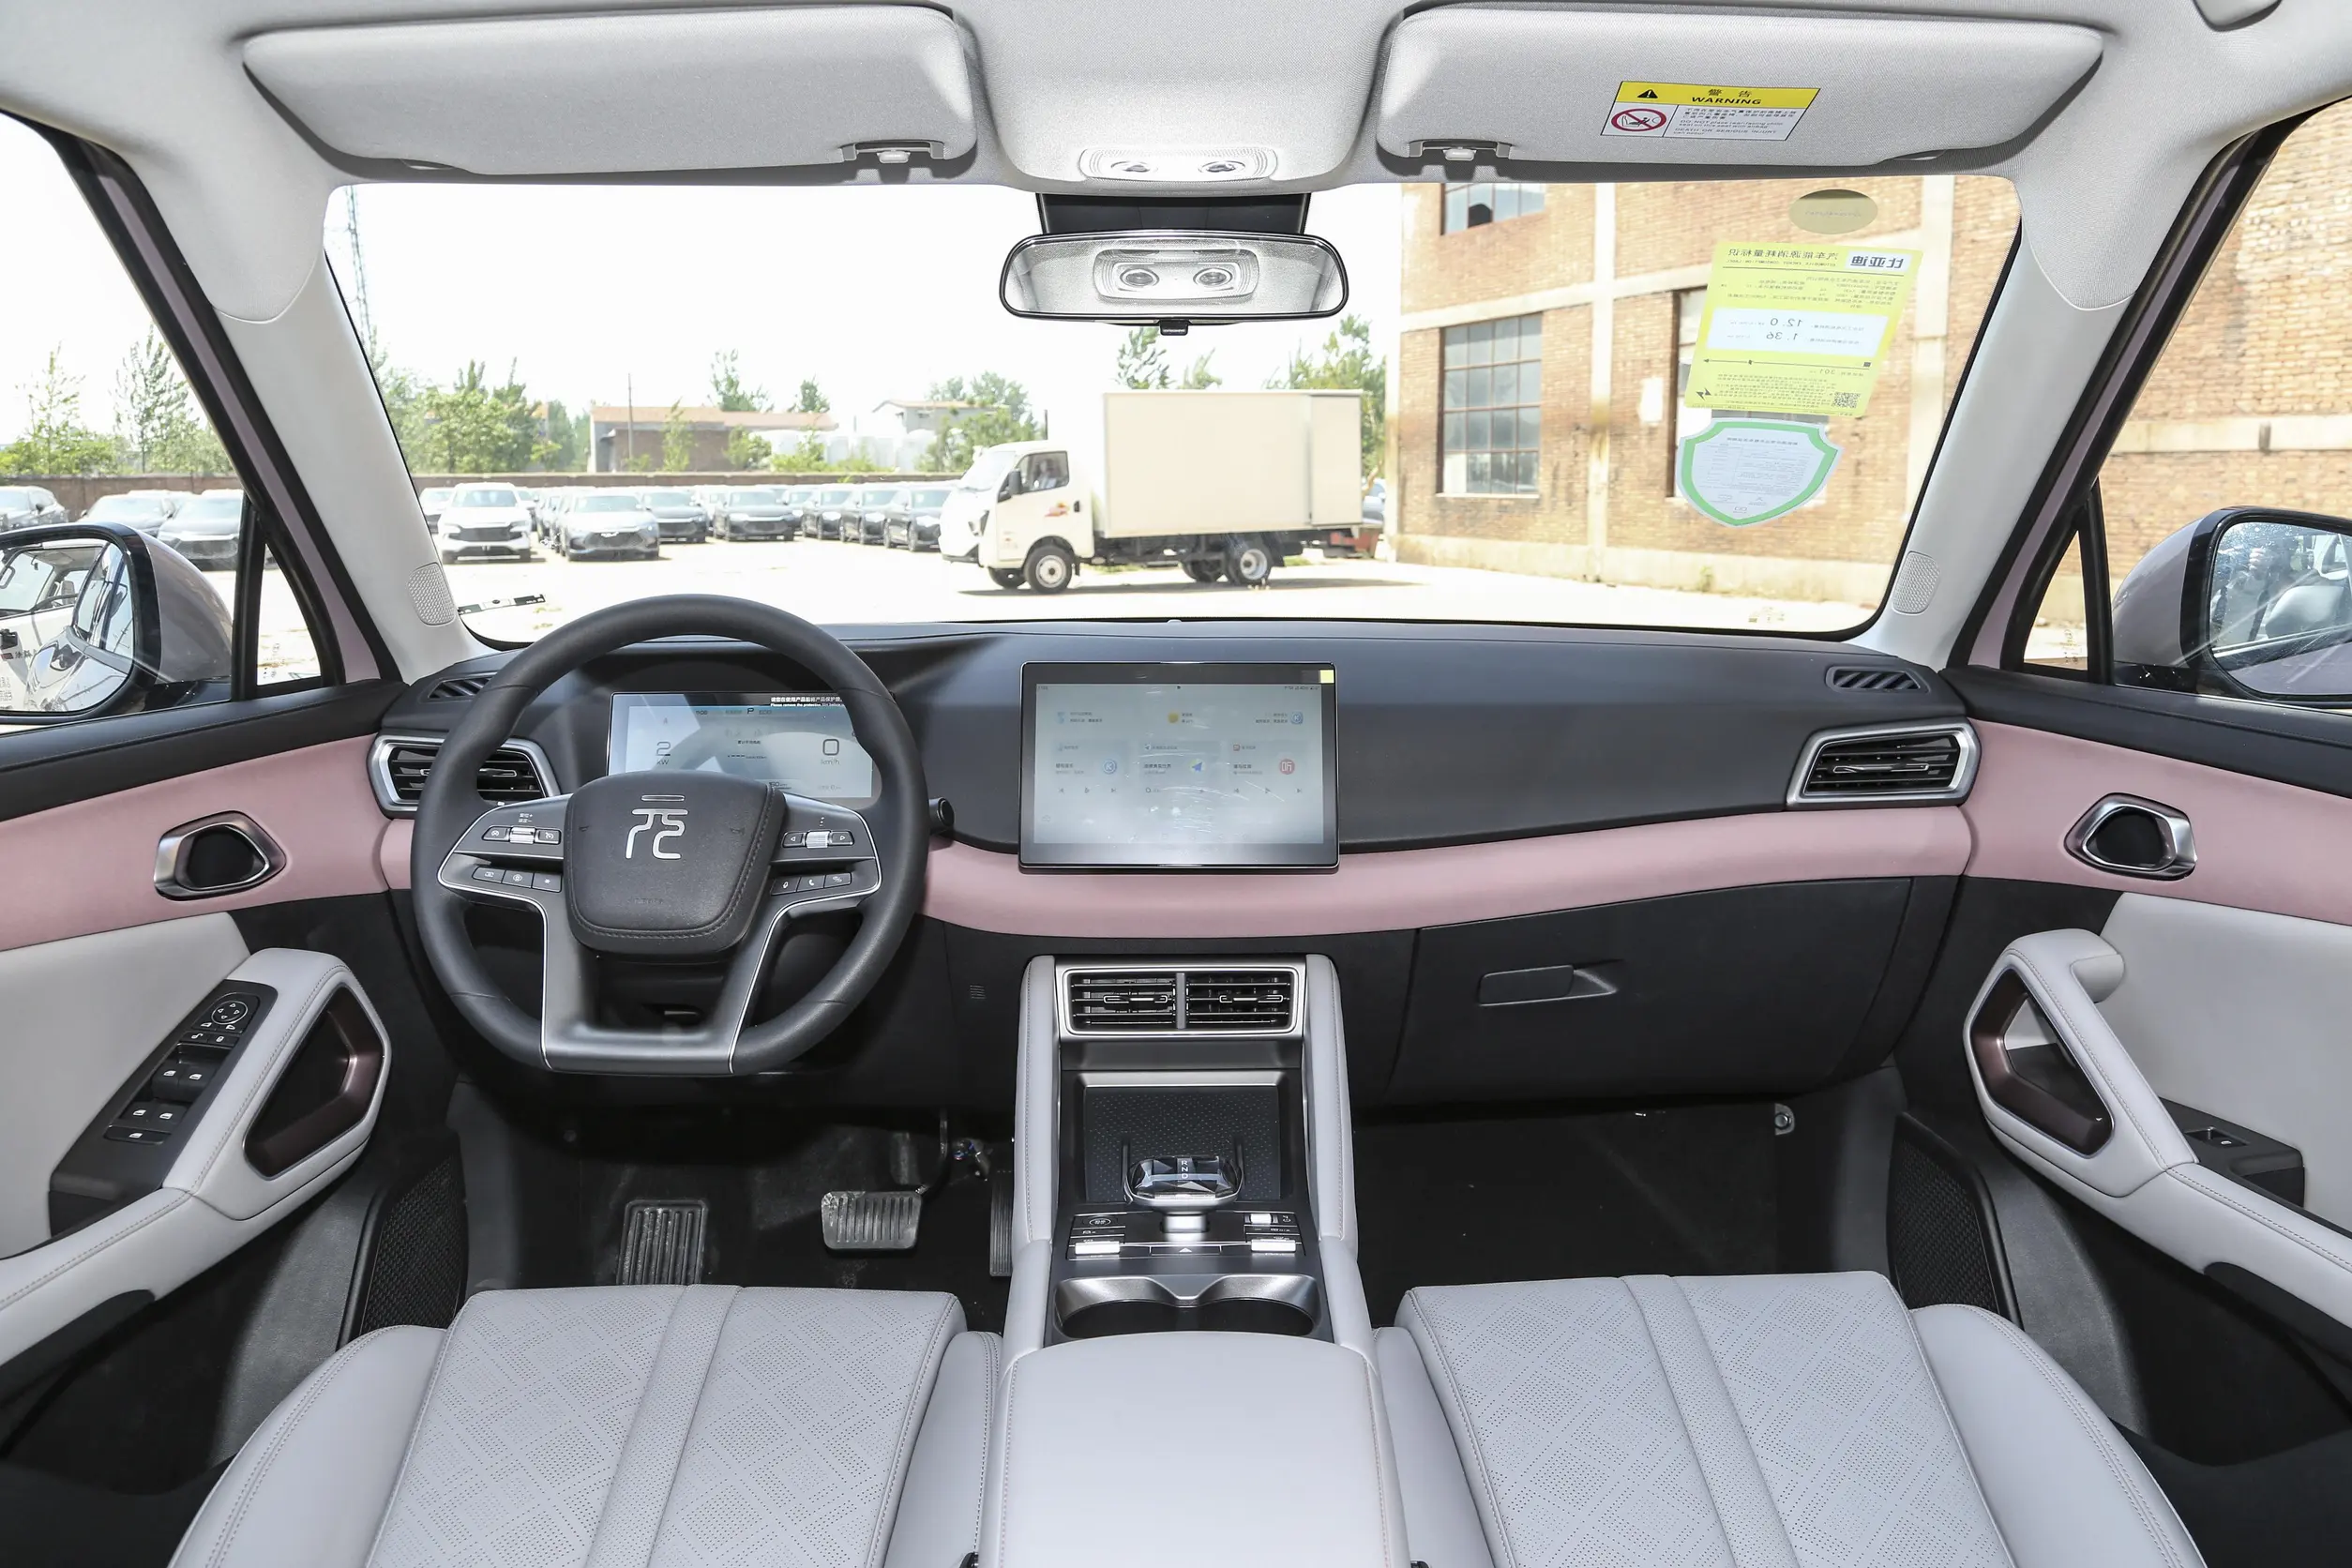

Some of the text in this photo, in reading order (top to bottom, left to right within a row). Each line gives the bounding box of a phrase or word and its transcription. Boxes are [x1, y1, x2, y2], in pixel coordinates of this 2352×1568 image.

[1692, 97, 1761, 105] WARNING
[656, 741, 671, 757] 2
[822, 738, 839, 756] 0
